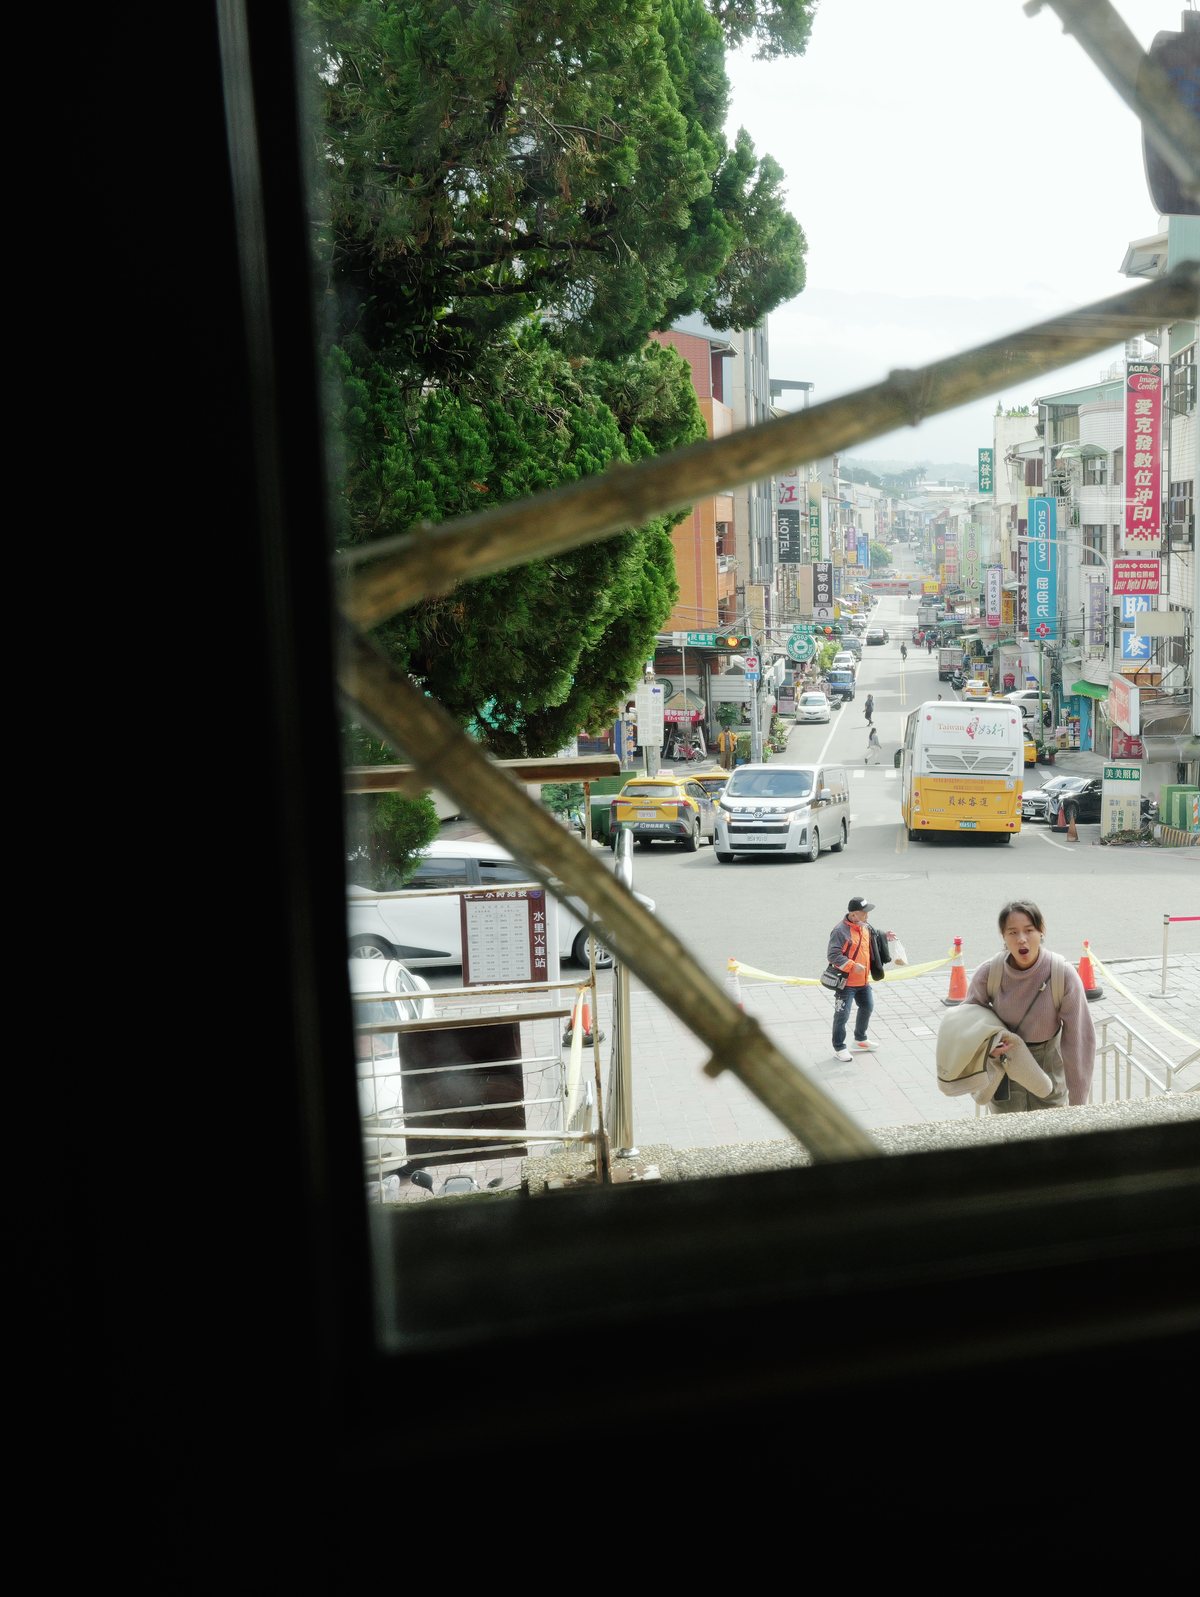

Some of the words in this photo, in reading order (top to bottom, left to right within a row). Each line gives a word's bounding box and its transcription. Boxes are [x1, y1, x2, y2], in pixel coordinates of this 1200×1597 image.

[1128, 365, 1149, 373] AGFA
[1139, 376, 1160, 385] Image
[1137, 382, 1159, 391] Center
[1133, 399, 1154, 521] 愛克發數位沖印
[779, 517, 790, 554] HOTEL
[1038, 510, 1046, 562] wasons
[938, 723, 965, 731] Taiwan
[533, 911, 546, 968] 水里火車站
